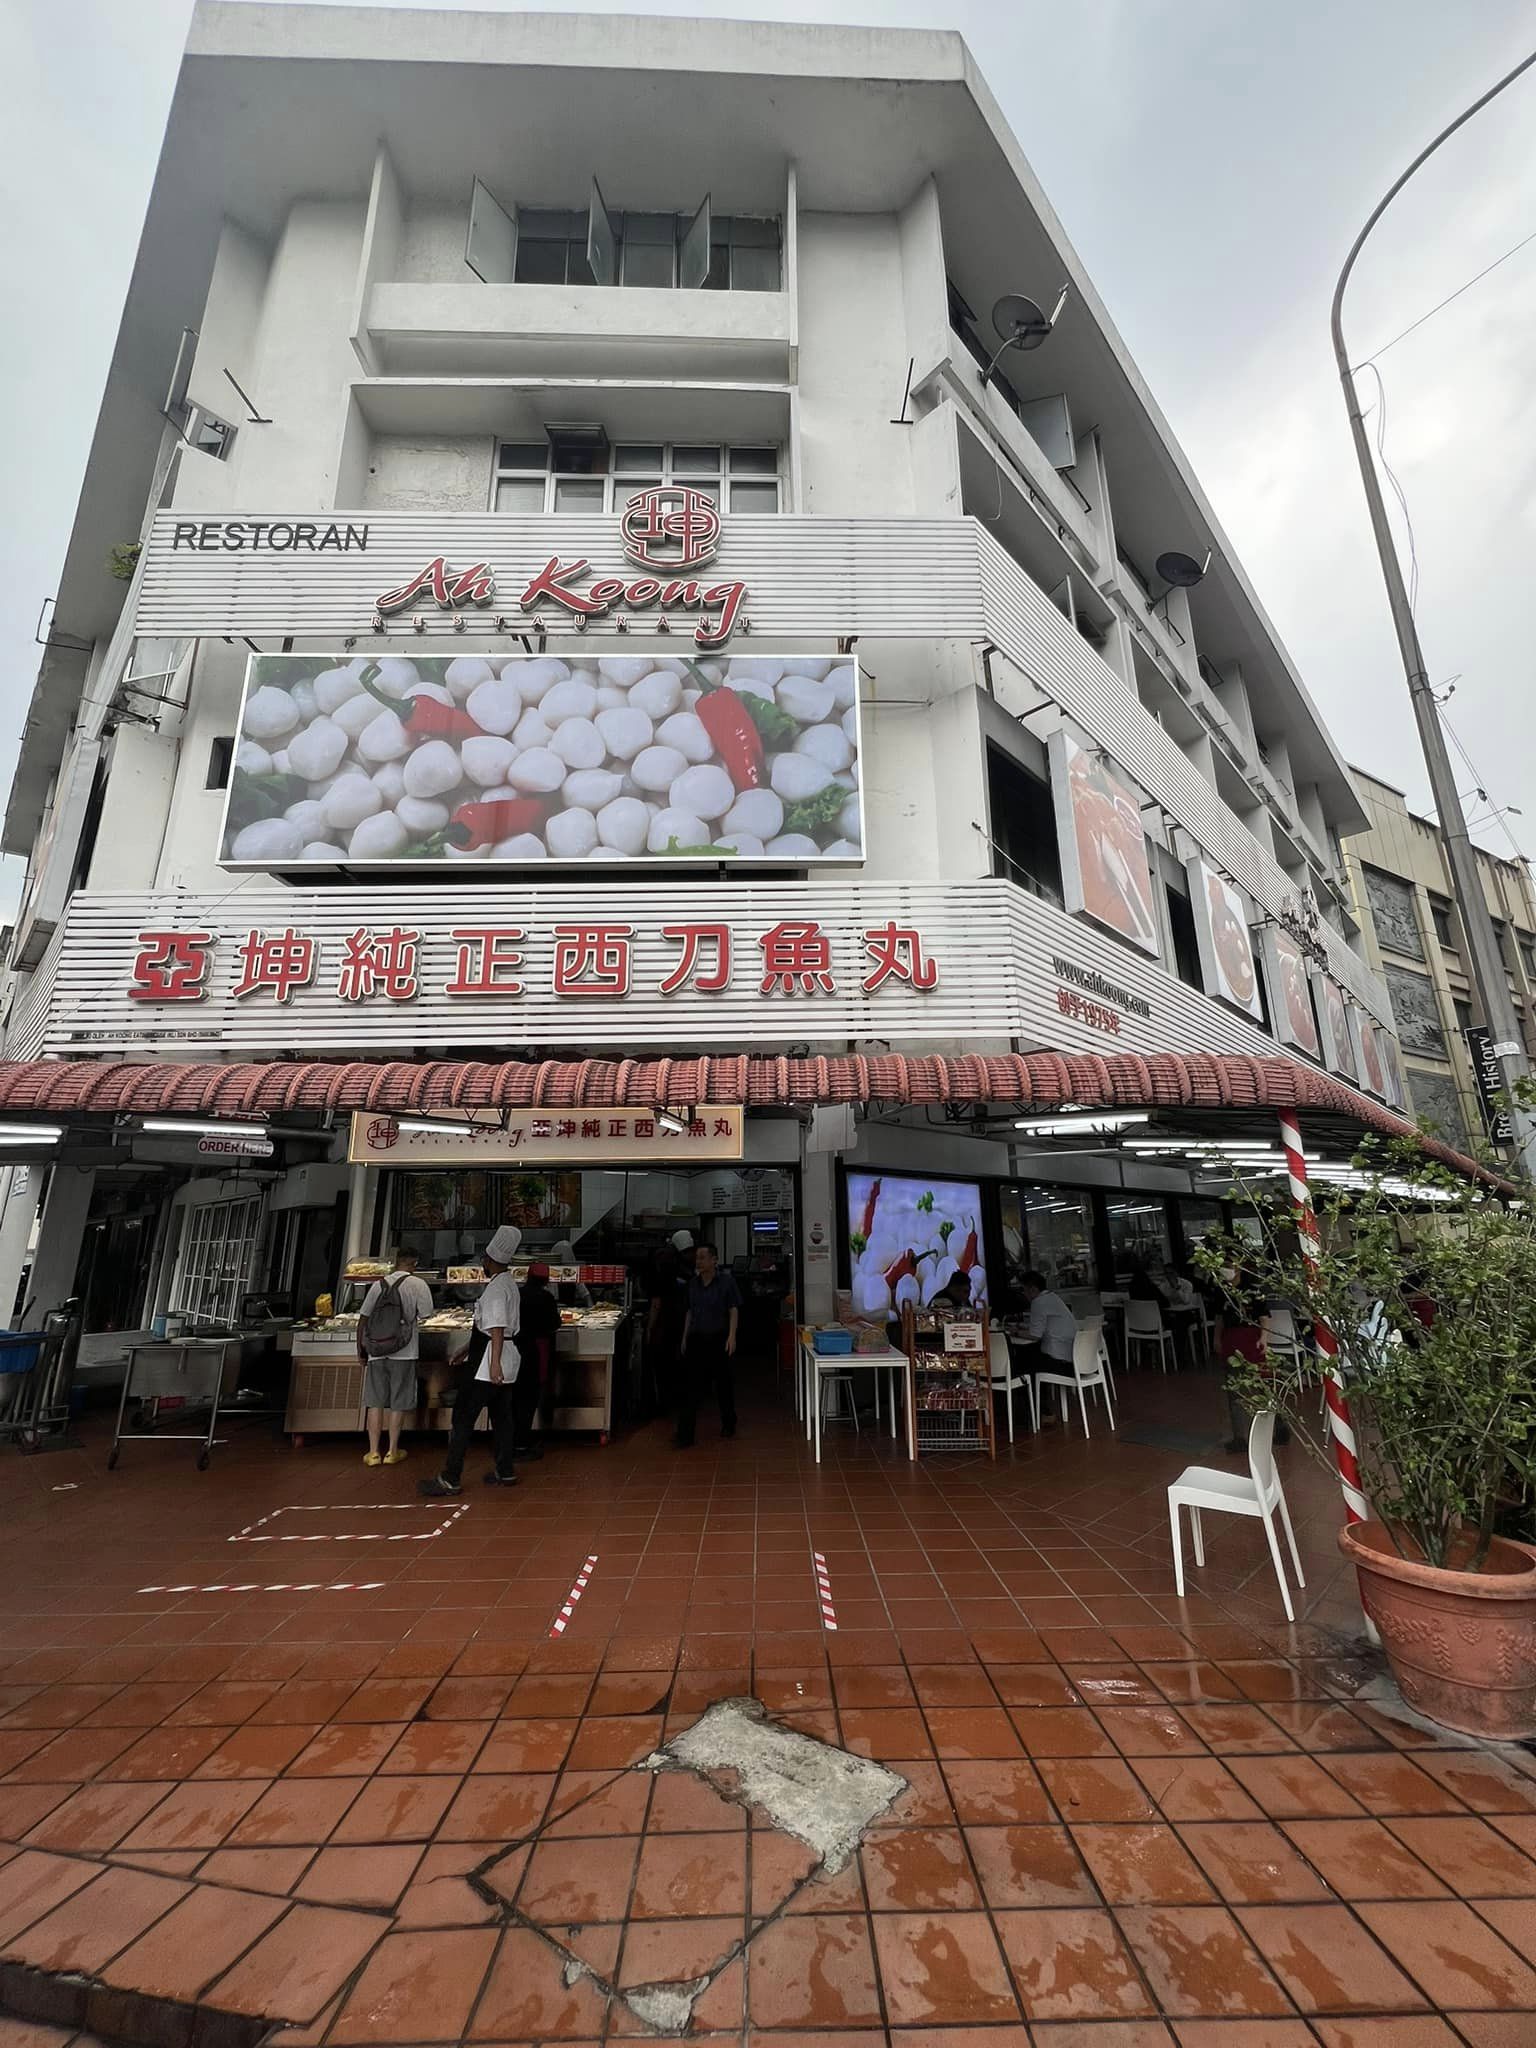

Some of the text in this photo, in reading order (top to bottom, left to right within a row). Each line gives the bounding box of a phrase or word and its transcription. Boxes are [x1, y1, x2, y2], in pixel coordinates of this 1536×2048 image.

[173, 522, 369, 551] RESTORAN
[371, 615, 751, 633] RESTAURANT
[375, 555, 751, 651] Ah Koong
[127, 920, 940, 1004] 亞坤純正西刀魚丸
[1478, 1036, 1512, 1139] History Bre
[199, 1140, 240, 1153] ORDER
